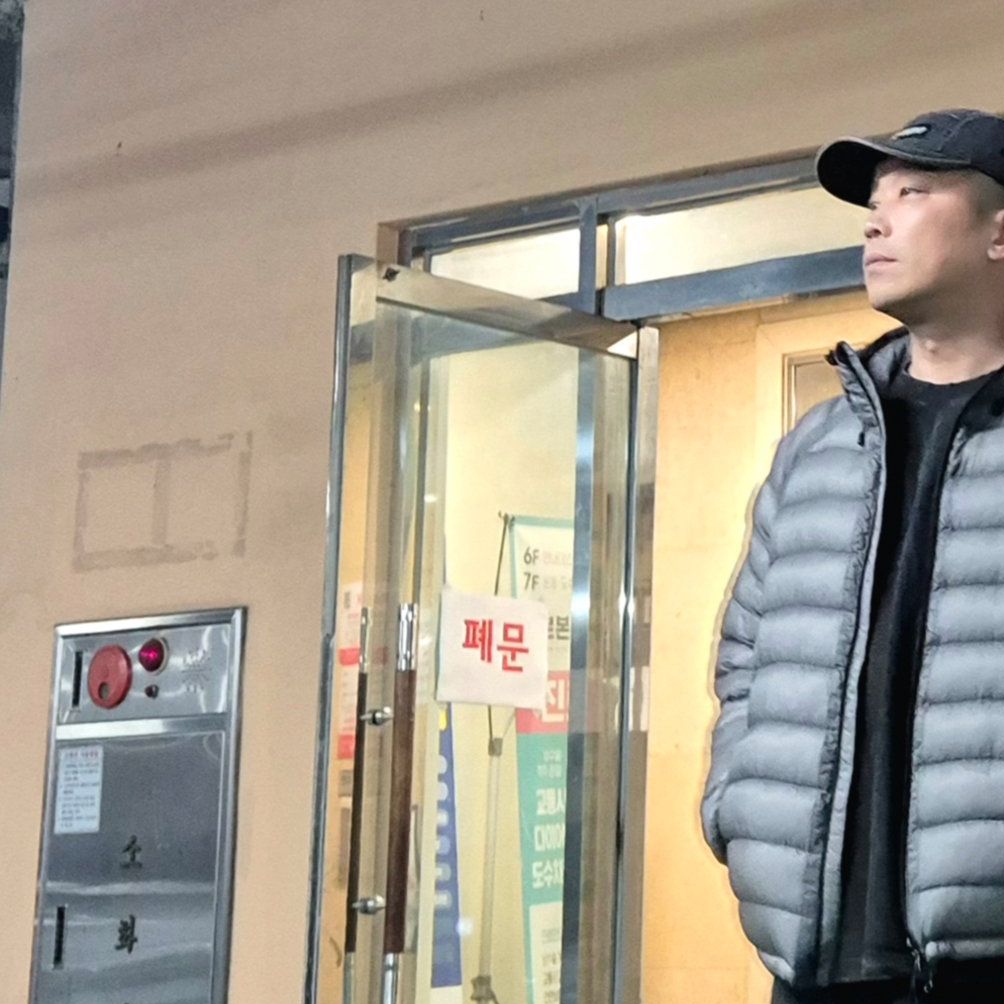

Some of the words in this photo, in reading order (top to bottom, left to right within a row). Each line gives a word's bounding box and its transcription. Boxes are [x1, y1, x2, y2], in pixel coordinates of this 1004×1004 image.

[523, 546, 540, 565] 6F
[524, 571, 540, 591] 7F
[462, 619, 529, 673] 폐문
